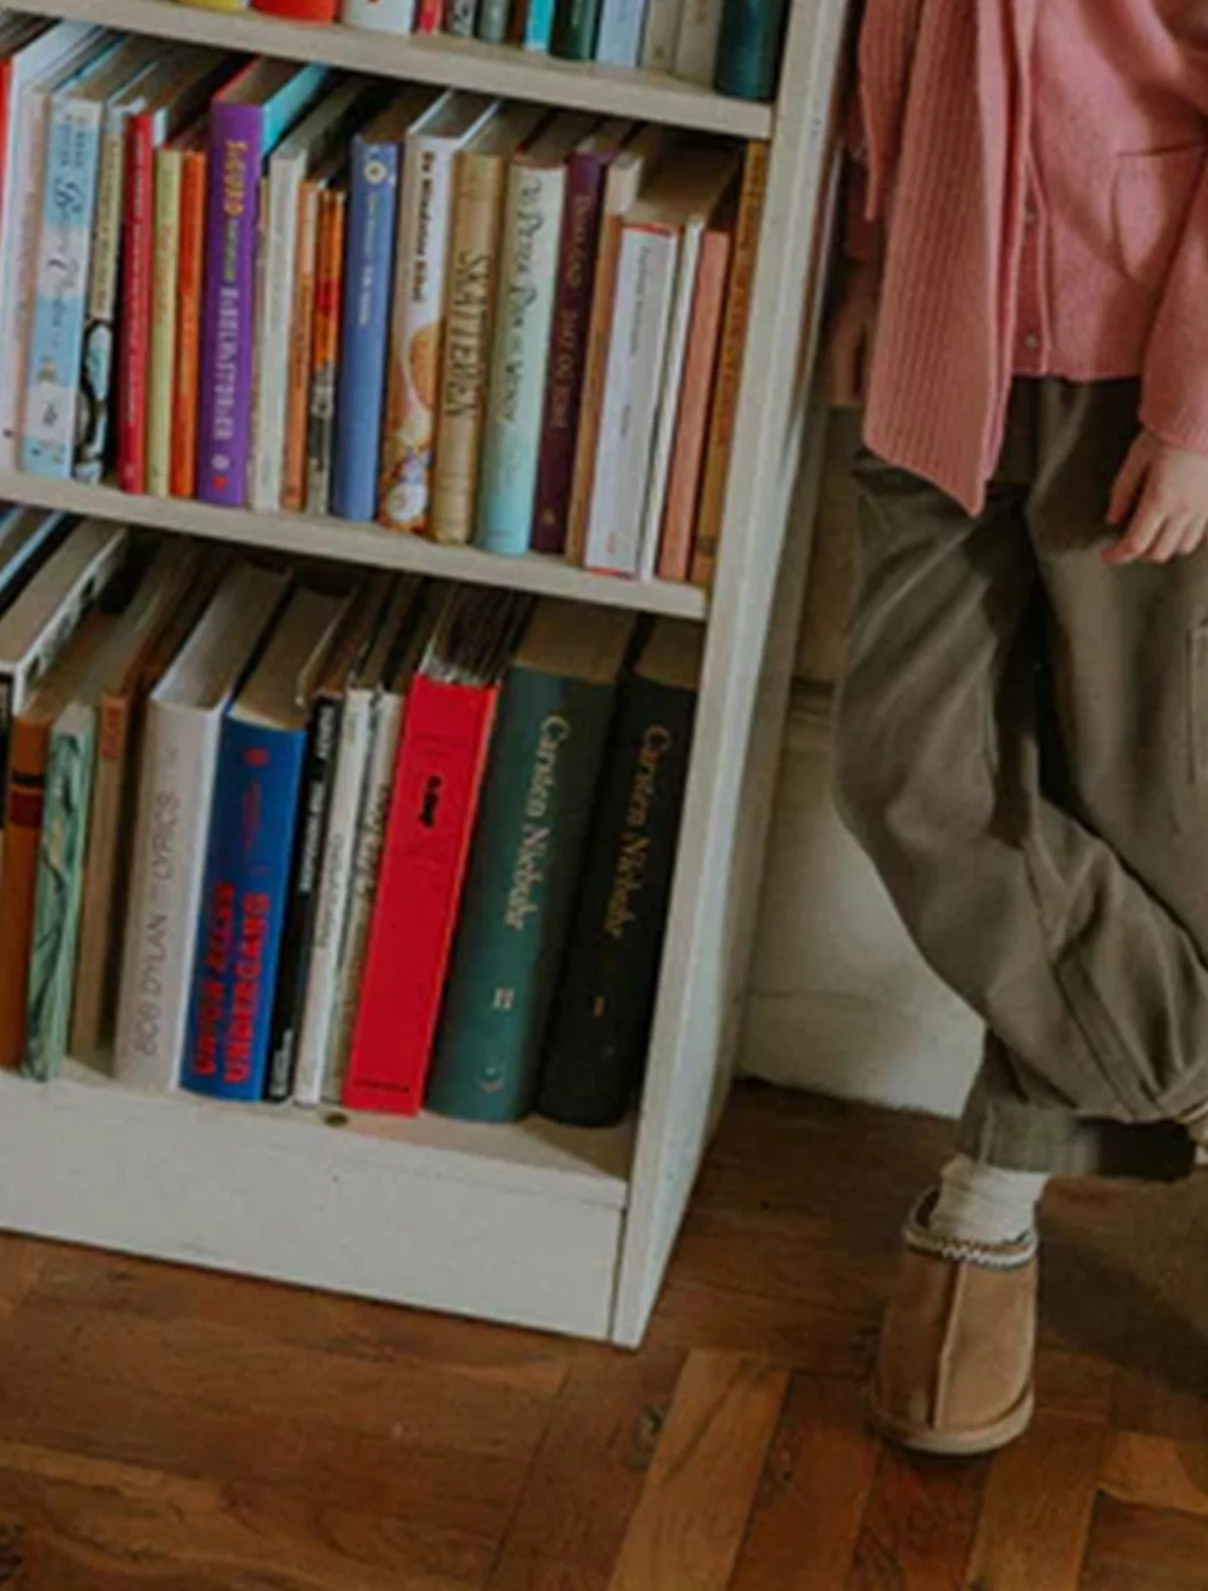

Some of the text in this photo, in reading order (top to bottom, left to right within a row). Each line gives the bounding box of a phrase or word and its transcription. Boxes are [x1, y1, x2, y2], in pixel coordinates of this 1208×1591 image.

[154, 790, 184, 882] LYRICS
[505, 712, 569, 932] Carsten Niebuhr
[604, 723, 671, 940] Carsten Niebuhr
[141, 912, 173, 996] DYLAN
[224, 892, 270, 1083] UNDERGANG
[136, 998, 163, 1056] BOB
